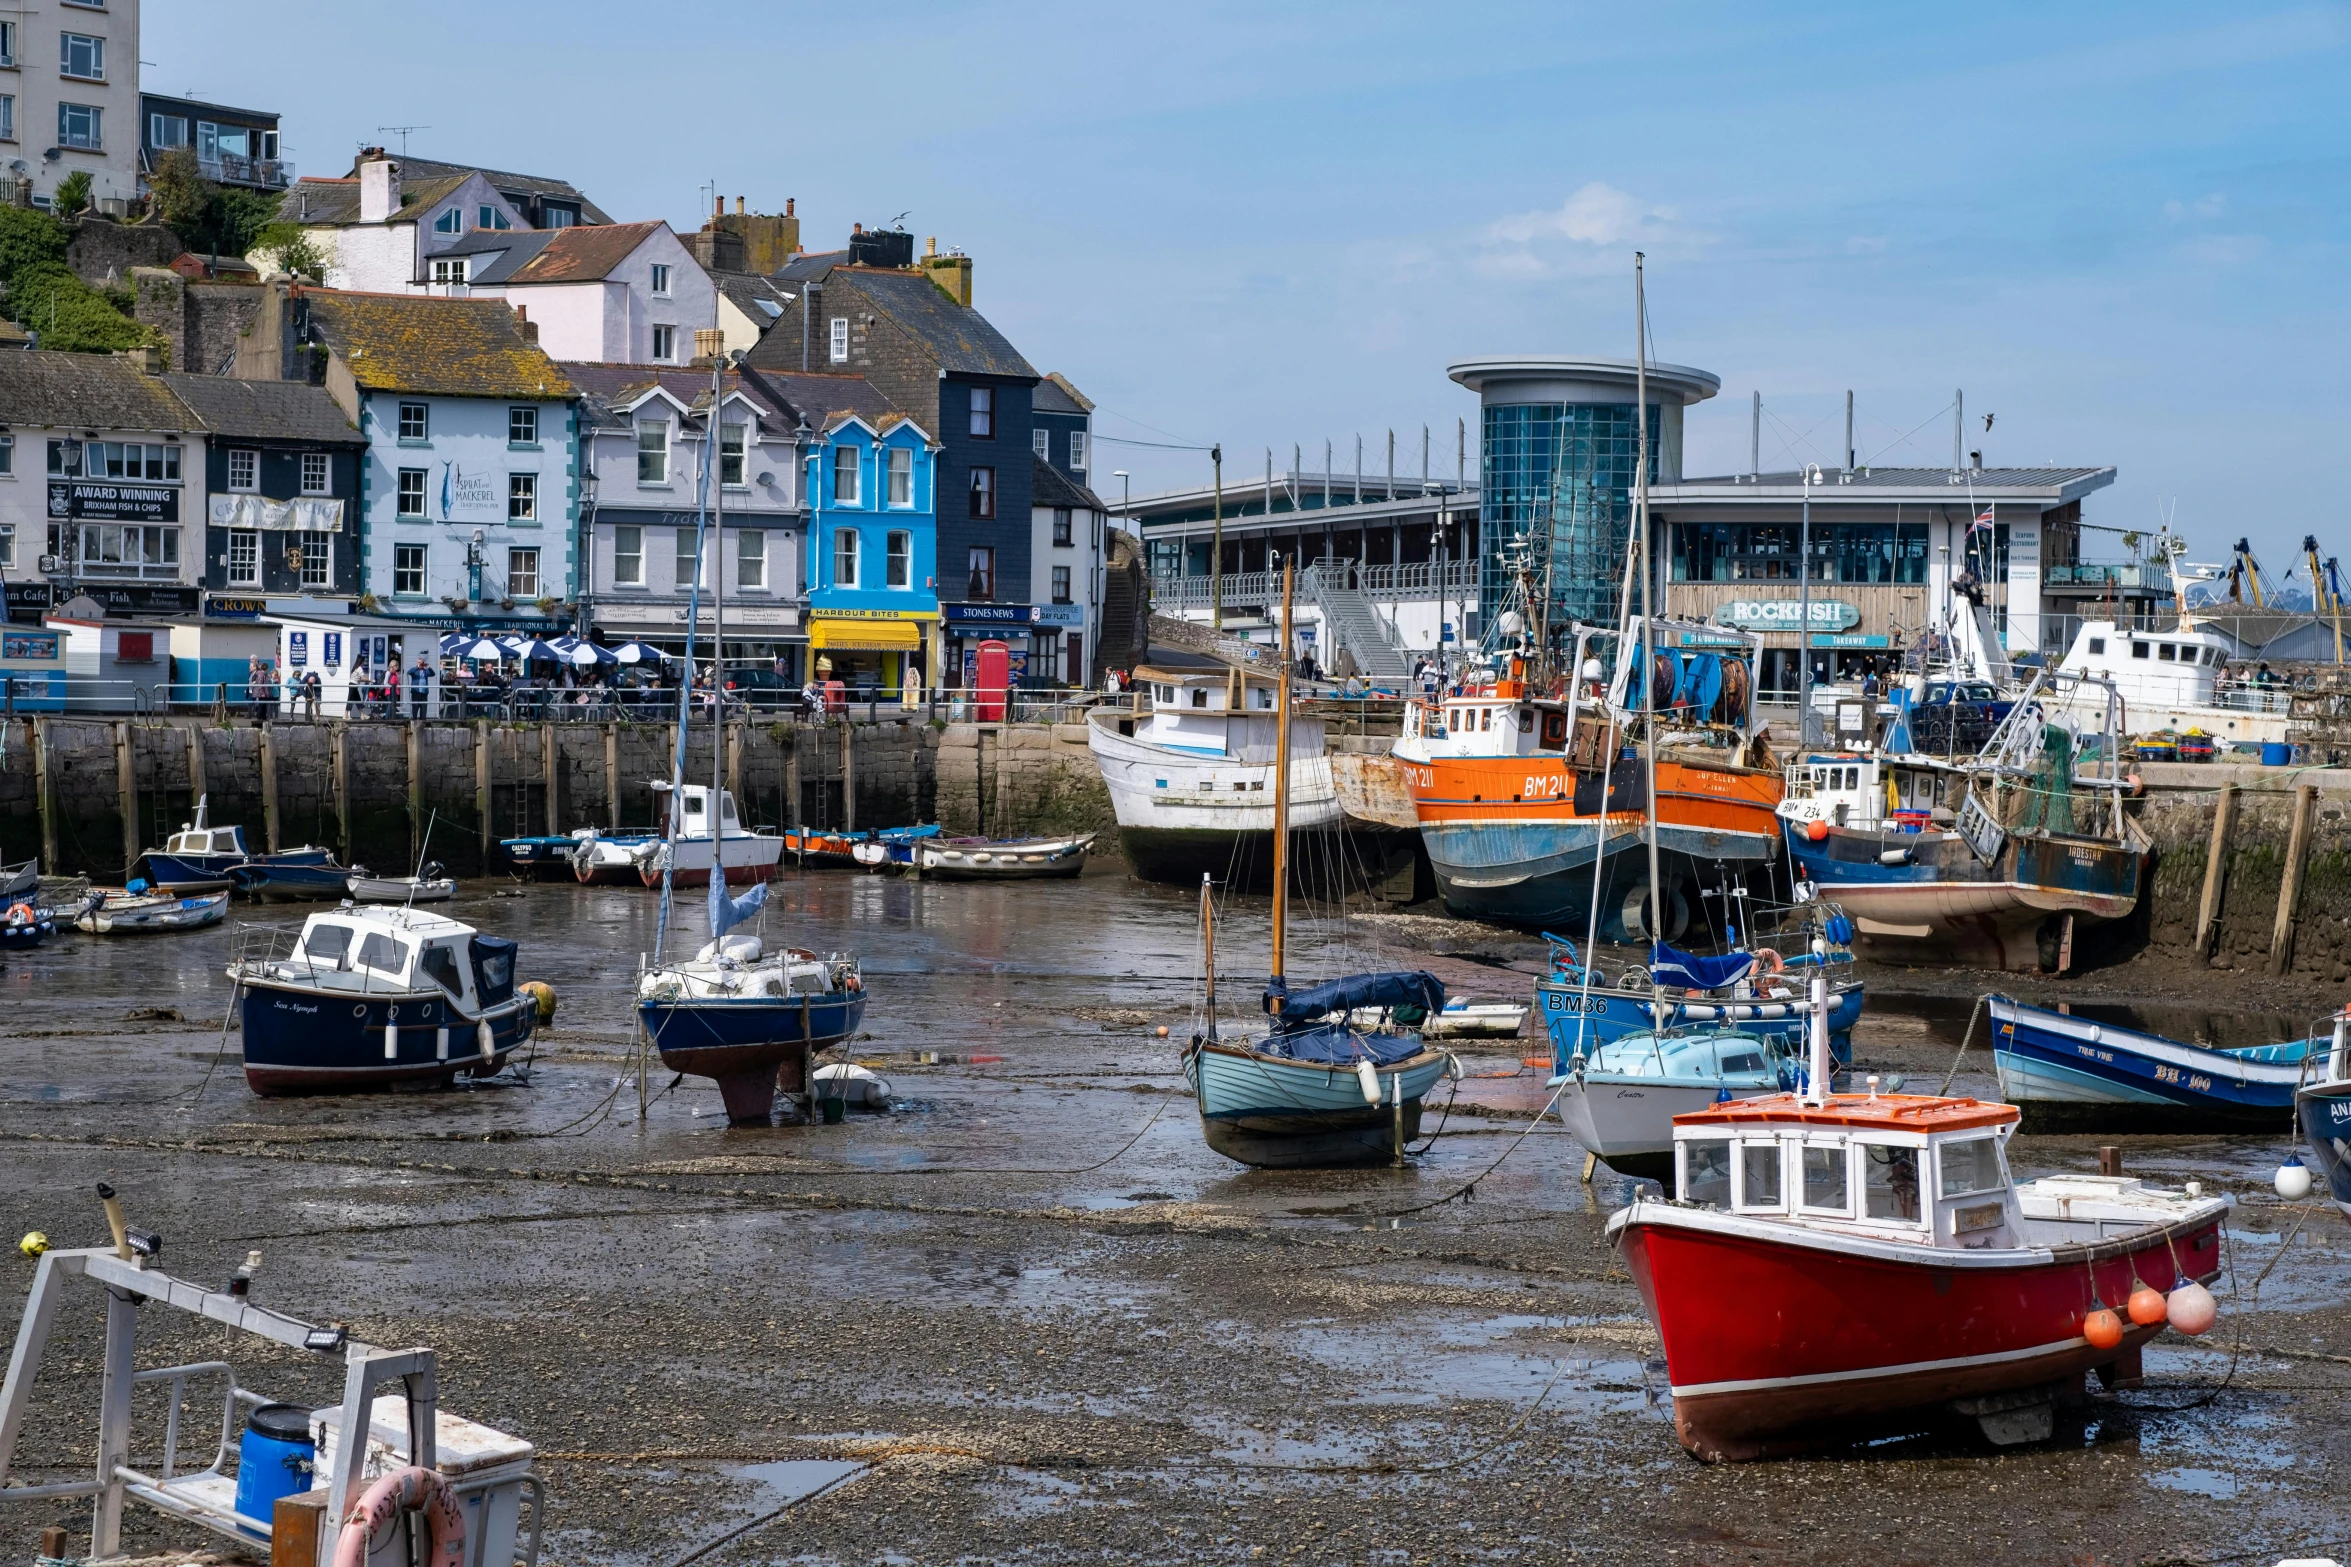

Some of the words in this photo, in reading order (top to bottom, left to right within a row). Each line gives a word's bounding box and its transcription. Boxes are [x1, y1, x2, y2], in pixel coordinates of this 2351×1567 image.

[460, 479, 481, 490] SPRAT
[74, 486, 117, 499] AWARD
[120, 488, 170, 501] WINNING
[456, 490, 496, 501] MACKEREL
[83, 501, 117, 510] BRIXHAM
[118, 502, 133, 511] FISH
[134, 503, 140, 511] &
[141, 503, 161, 512] CHIPS
[215, 500, 267, 517] CROWN
[23, 589, 47, 601] Cafe
[109, 591, 130, 603] Fish
[151, 591, 179, 599] Restaurant
[155, 599, 181, 607] Takeaway
[213, 600, 266, 611] CROWN
[816, 609, 866, 617] HARBOUR
[963, 608, 992, 618] STONES
[992, 608, 1014, 618] NEWS
[1043, 605, 1079, 614] HARBOURSIDE
[1734, 602, 1842, 621] ROCKFISH
[429, 619, 466, 629] MACKEREL
[504, 621, 543, 630] TRADITIONAL
[547, 622, 558, 630] PUB
[1832, 636, 1867, 645] TAKEAWAY
[1403, 766, 1419, 786] BM
[1419, 768, 1434, 787] 211
[1524, 775, 1547, 797] BM
[1548, 774, 1569, 795] 211
[1782, 802, 1795, 812] BM
[1803, 805, 1820, 818] 234
[2068, 846, 2102, 861] JADESTAR
[273, 1000, 288, 1009] Sea
[289, 1002, 319, 1014] Nymph
[1548, 994, 1608, 1015] BM36
[2077, 1045, 2095, 1058] TRUE
[2096, 1050, 2114, 1062] VINE
[2154, 1064, 2180, 1084] BH
[2188, 1074, 2212, 1093] 100
[1617, 1089, 1645, 1099] Cuattro
[2330, 1101, 2351, 1118] AN
